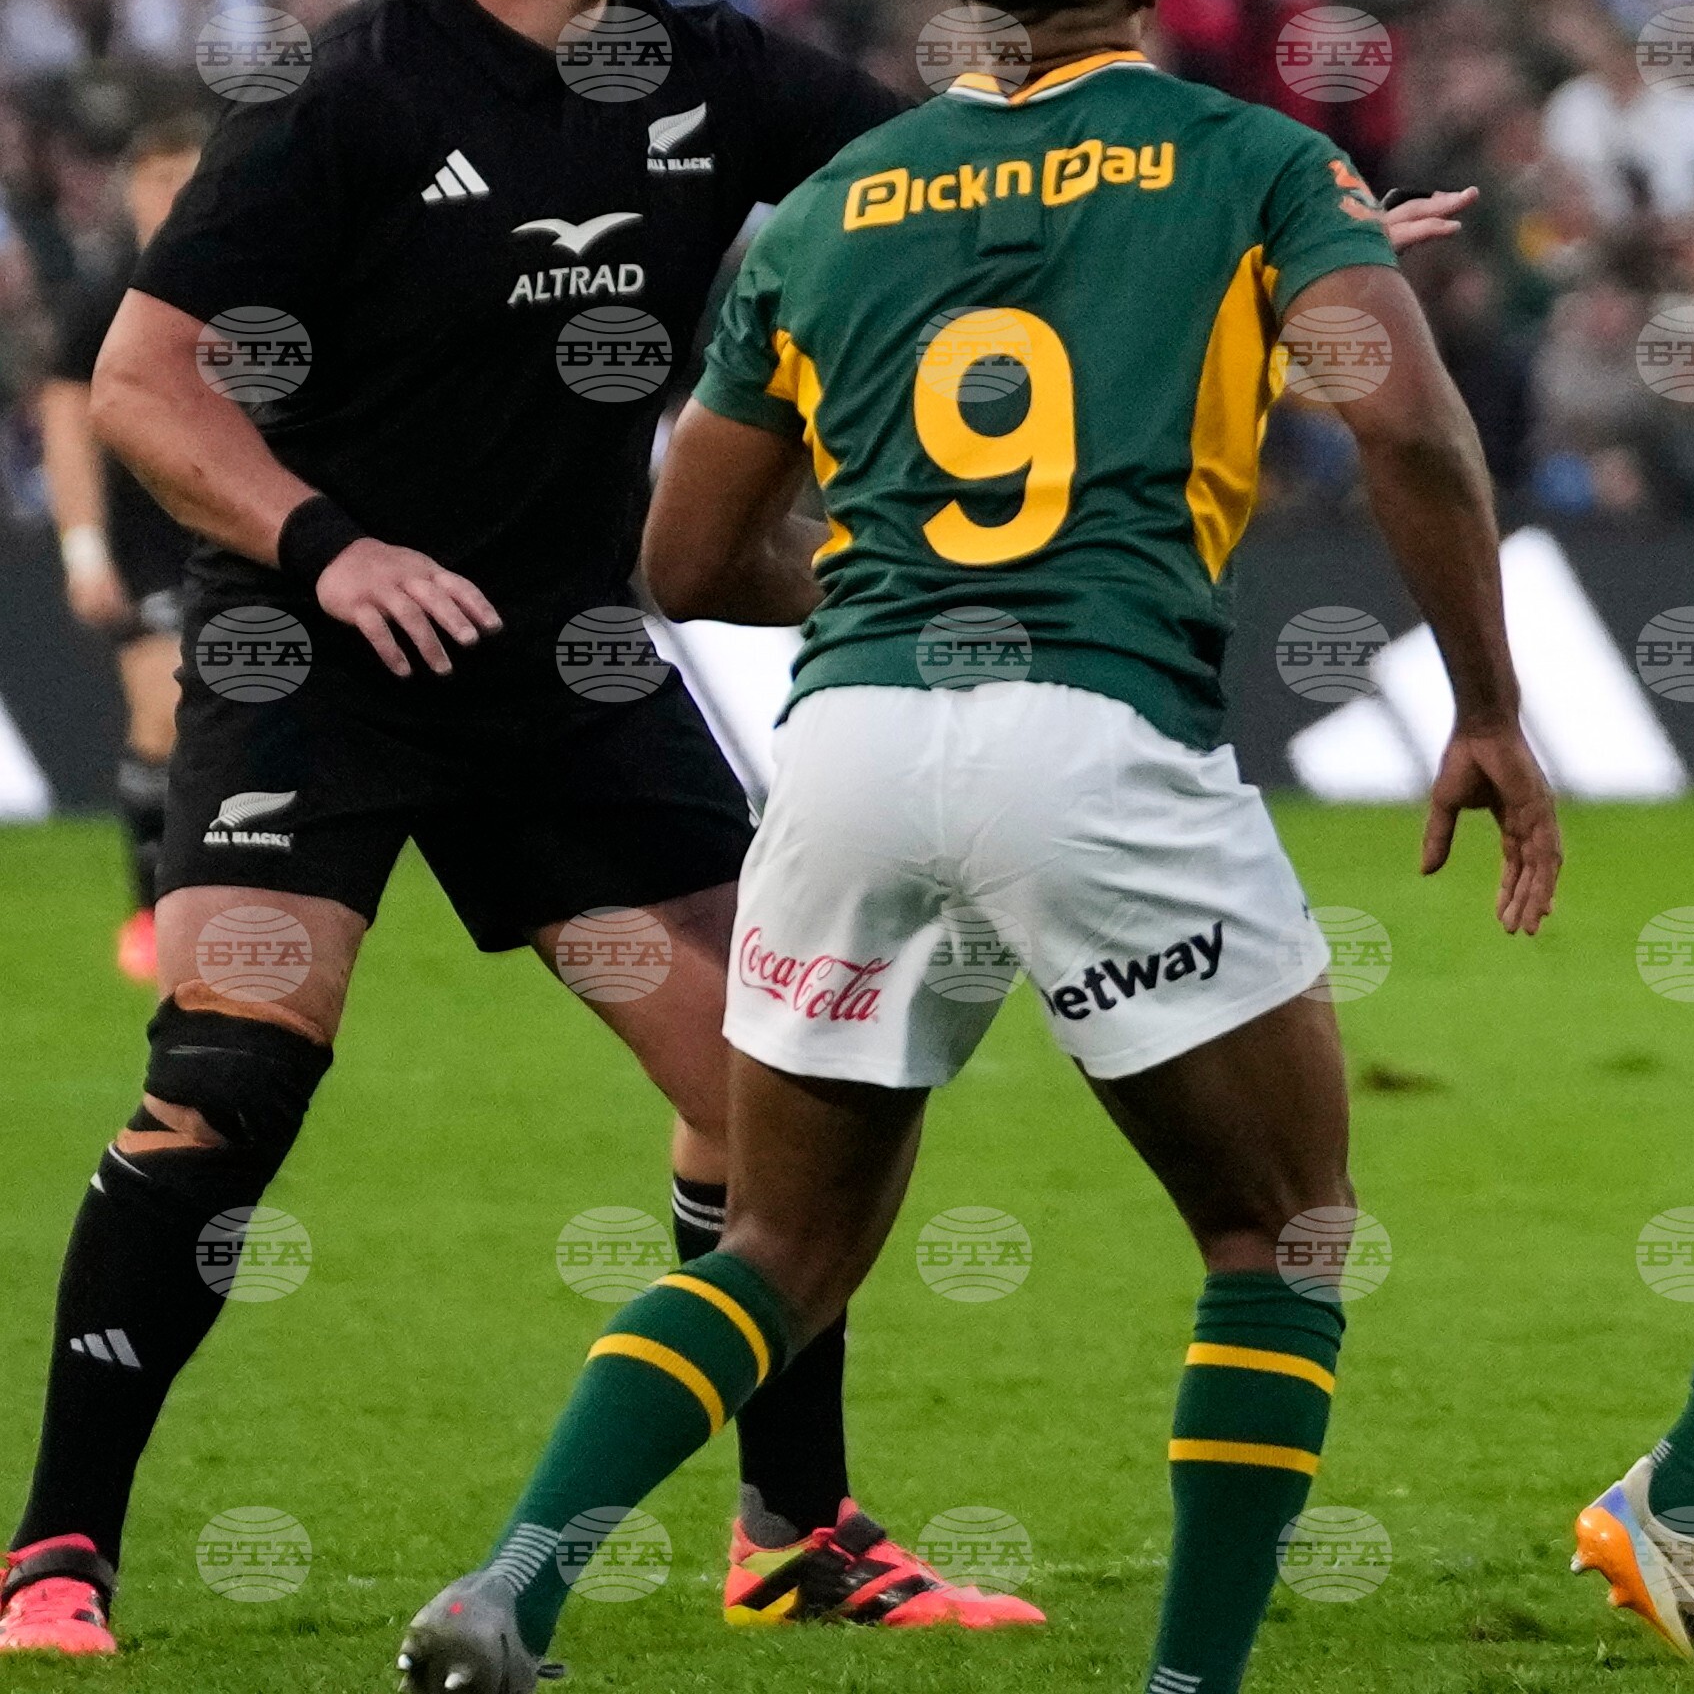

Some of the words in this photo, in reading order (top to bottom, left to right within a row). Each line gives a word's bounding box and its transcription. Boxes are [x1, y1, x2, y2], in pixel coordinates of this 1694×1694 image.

[844, 164, 988, 231] Pick
[995, 160, 1033, 199] n
[1041, 139, 1174, 207] Pay
[506, 263, 645, 305] ALTRAD
[913, 306, 1076, 567] 9
[203, 830, 229, 844] ALL
[231, 830, 291, 848] BLACKS
[739, 925, 896, 1021] Coca-Cola
[1040, 919, 1223, 1021] etway
